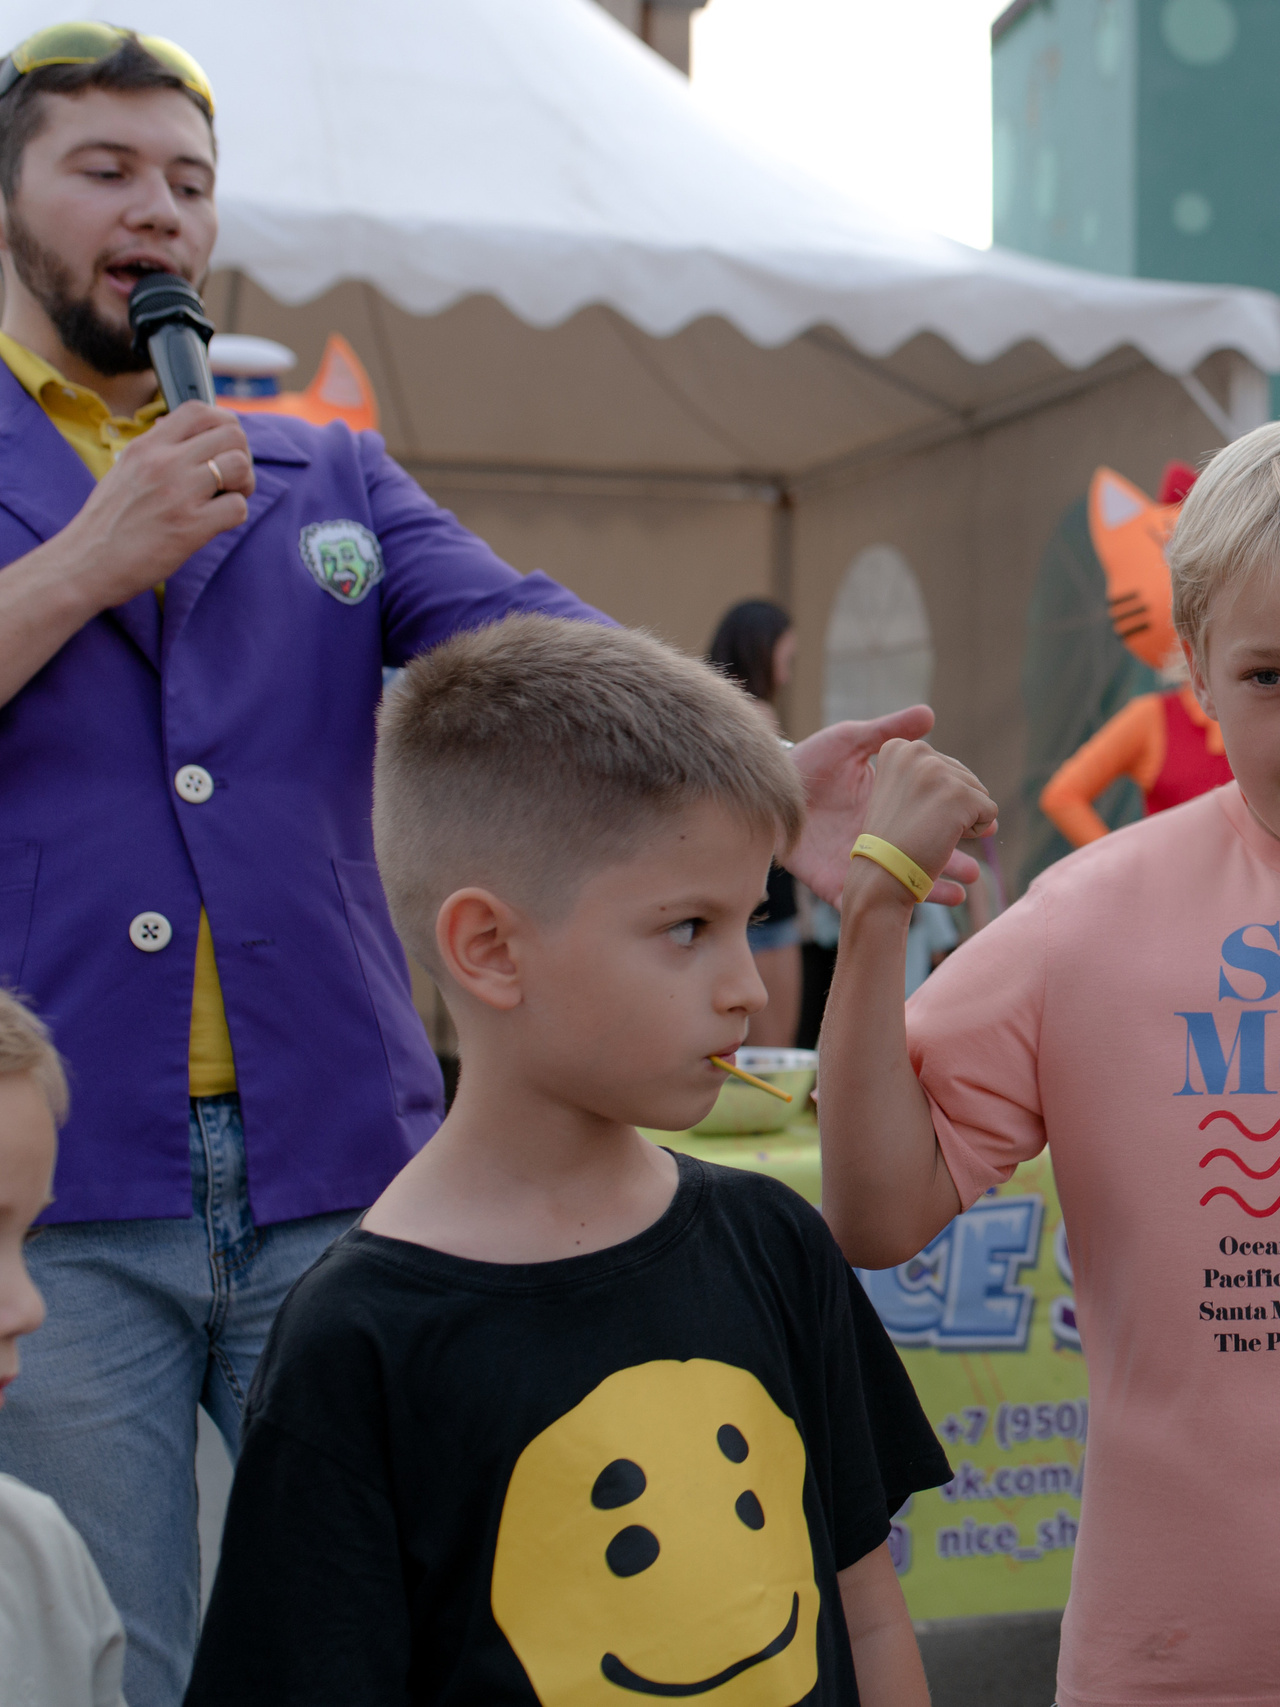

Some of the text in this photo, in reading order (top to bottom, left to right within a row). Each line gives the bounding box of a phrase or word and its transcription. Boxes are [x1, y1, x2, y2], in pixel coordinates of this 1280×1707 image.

[1199, 1301, 1268, 1321] Santa
[1213, 1333, 1262, 1353] The
[938, 1406, 988, 1445] +7
[936, 1508, 1080, 1560] nice_sh
